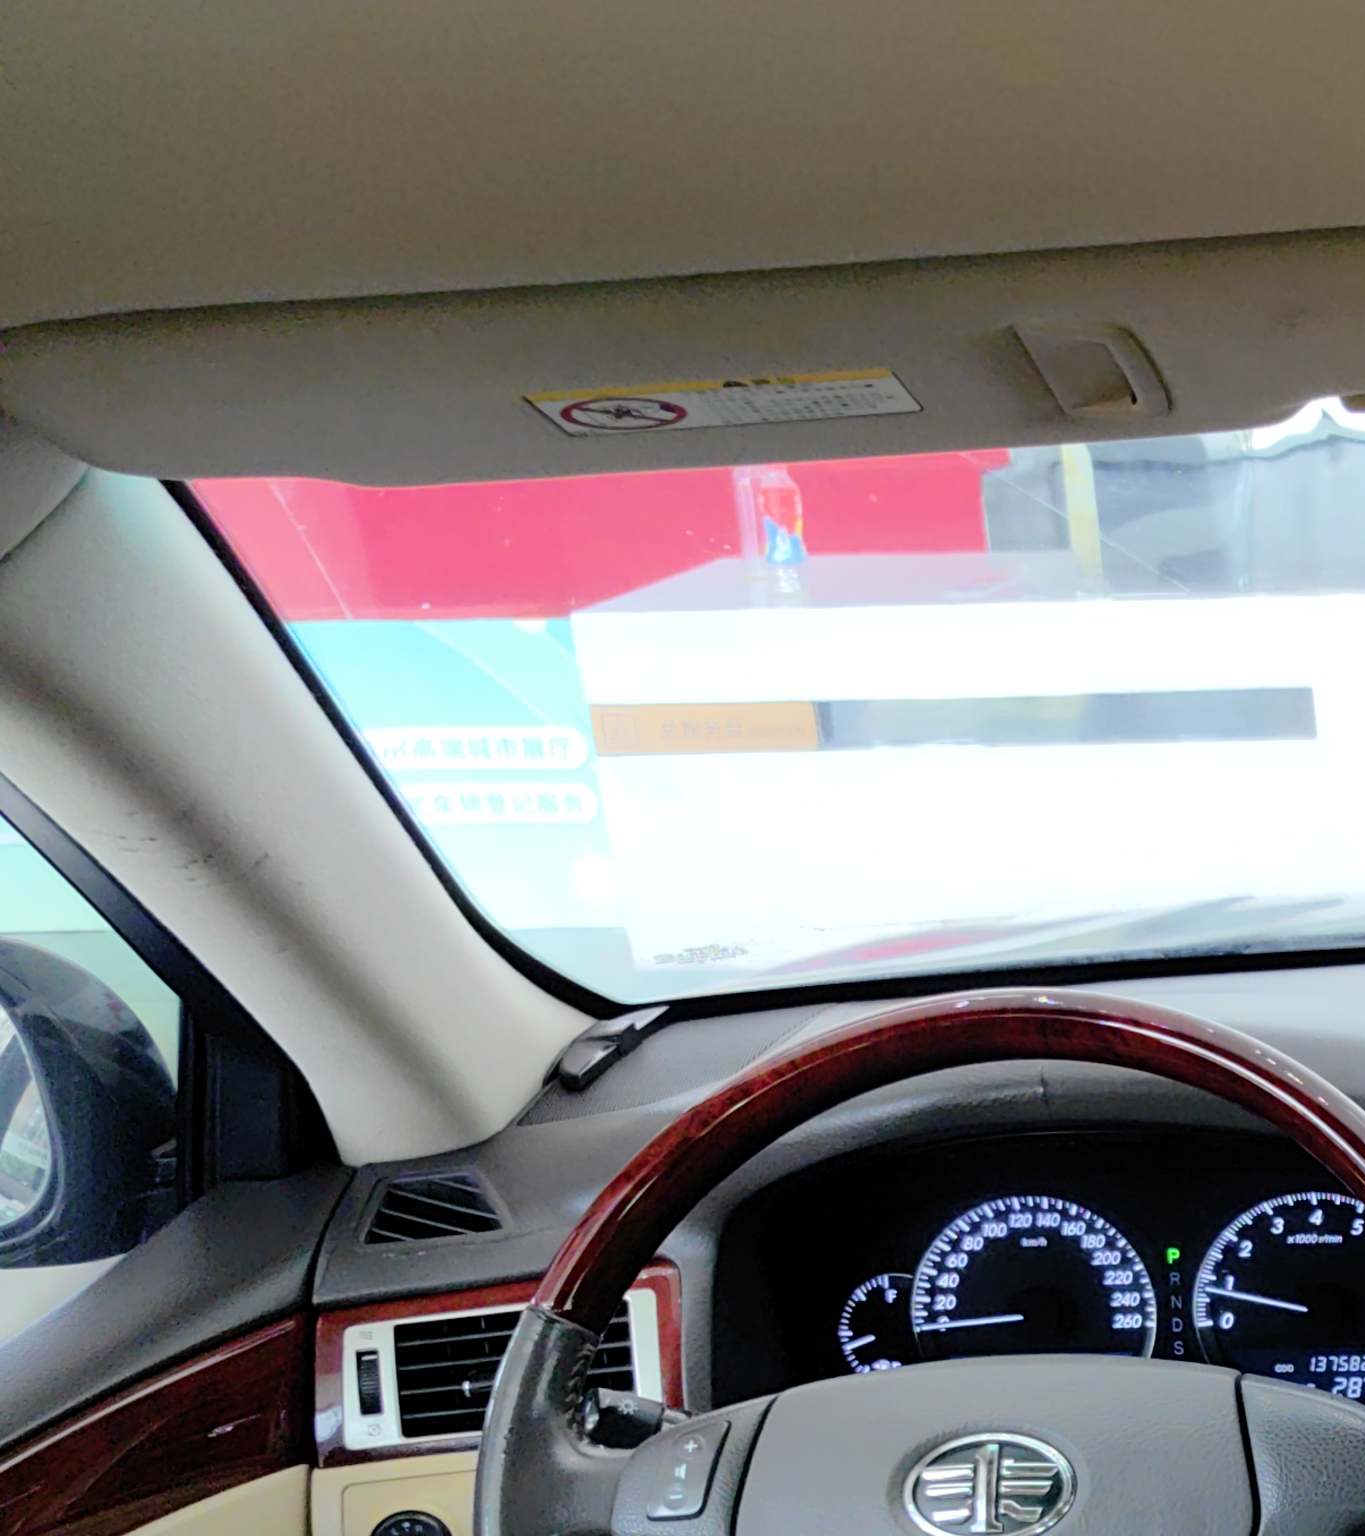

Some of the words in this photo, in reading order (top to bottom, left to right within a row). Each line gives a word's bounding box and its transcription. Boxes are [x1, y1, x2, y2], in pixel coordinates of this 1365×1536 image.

[1008, 1213, 1033, 1228] 120
[1036, 1213, 1061, 1227] 140
[1308, 1208, 1324, 1226] 4
[981, 1223, 1008, 1238] 100
[1061, 1221, 1086, 1236] 160
[1270, 1217, 1285, 1235] 3
[1350, 1219, 1365, 1236] 5
[961, 1236, 984, 1251] 80
[1080, 1235, 1106, 1249] 180
[1238, 1240, 1253, 1259] 2
[945, 1252, 969, 1268] 60
[1091, 1251, 1122, 1266] 200
[1166, 1248, 1180, 1265] P
[937, 1272, 960, 1288] 40
[1102, 1271, 1133, 1286] 220
[1169, 1272, 1181, 1287] R
[885, 1288, 898, 1304] F
[933, 1294, 957, 1310] 20
[1109, 1291, 1140, 1308] 240
[1171, 1295, 1182, 1310] N
[1111, 1313, 1143, 1329] 260
[1172, 1317, 1183, 1333] D
[1219, 1312, 1235, 1330] 0
[1173, 1340, 1184, 1356] S
